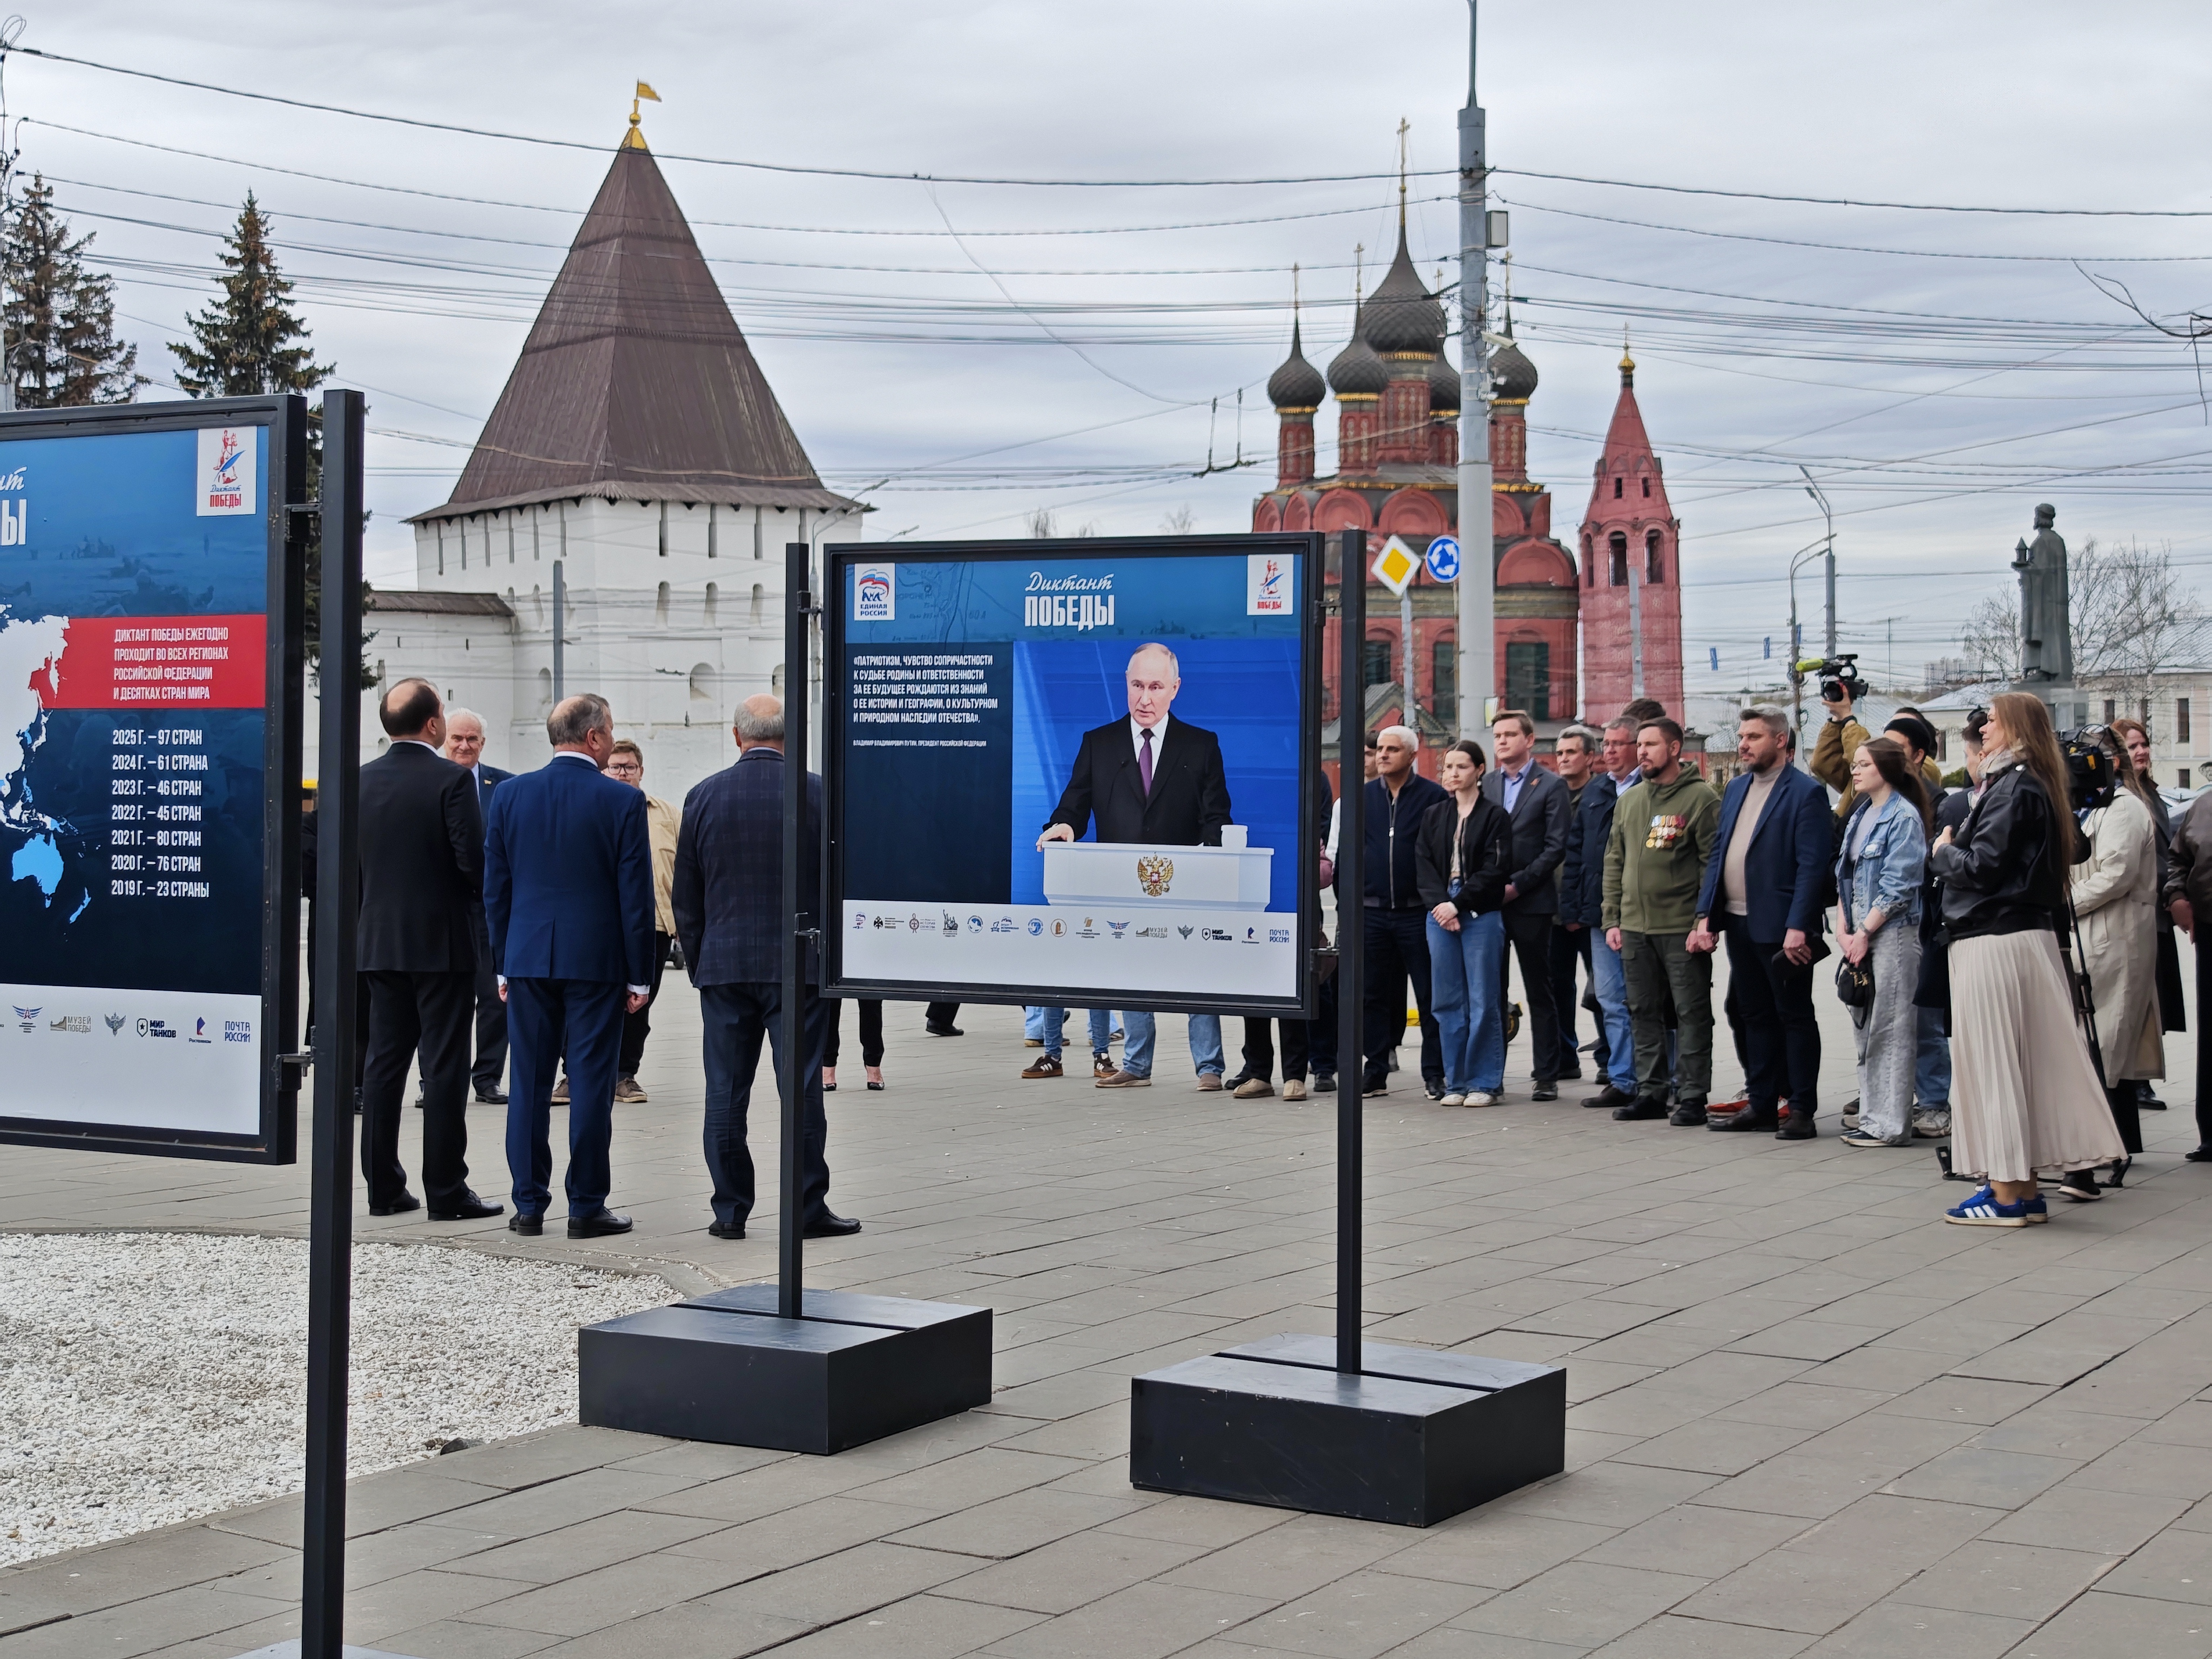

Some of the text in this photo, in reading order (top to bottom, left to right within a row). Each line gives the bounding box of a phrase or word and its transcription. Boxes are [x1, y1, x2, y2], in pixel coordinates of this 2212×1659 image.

[210, 494, 241, 509] ПОБЕДЫ
[1025, 571, 1114, 591] Диктант
[1024, 595, 1115, 632] ПОБЕДЫ
[114, 627, 228, 643] ДИКТАНТ ПОБЕДЫ ЕЖЕГОДНО
[114, 647, 228, 662] ПРОХОДИТ ВО ВСЕХ РЕГИОНАХ
[854, 655, 993, 666] «ПАТРИОТИЗМ, ЧУВСТВО СОПРИЧАСТНОСТИ
[114, 665, 213, 680] РОССИЙСКОЙ ФЕДЕРАЦИИ
[854, 670, 984, 681] К СУДЬБЕ РОДИНЫ И ОТВЕТСТВЕННОСТИ
[113, 686, 210, 701] И ДЕСЯТКАХ СТРАН МИРА
[854, 683, 988, 695] ЗА ЕЕ БУДУЩЕЕ РОЖДАЮТСЯ ИЗ ЗНАНИЙ
[853, 698, 998, 710] О ЕЕ ИСТОРИИ И ГЕОГРАФИИ, О КУЛЬТУРНОМ
[853, 713, 858, 723] И
[859, 713, 899, 724] ПРИРОДНОМ
[901, 713, 937, 724] НАСЛЕДИИ
[113, 730, 136, 745] 2025
[138, 730, 146, 745] Г.
[158, 730, 171, 745] 97
[172, 730, 203, 745] СТРАН
[112, 754, 136, 770] 2024
[138, 755, 146, 770] Г.
[158, 755, 170, 770] 61
[172, 755, 208, 771] СТРАНА
[112, 780, 136, 795] 2023
[138, 780, 146, 795] Г.
[157, 780, 170, 795] 46
[172, 780, 201, 795] СТРАН
[112, 805, 136, 820] 2022
[138, 805, 146, 820] Г.
[157, 806, 170, 821] 45
[171, 806, 201, 821] СТРАН
[111, 830, 134, 845] 2021
[137, 831, 146, 845] Г.
[157, 831, 169, 846] 80
[171, 831, 201, 846] СТРАН
[111, 855, 135, 870] 2020
[137, 855, 145, 871] Г.
[157, 856, 169, 871] 76
[171, 856, 201, 872] СТРАН
[111, 880, 135, 895] 2019
[137, 881, 145, 895] Г.
[157, 881, 169, 896] 23
[171, 881, 209, 898] СТРАНЫ
[68, 1016, 91, 1024] МУЗЕЙ
[150, 1020, 165, 1028] МИР
[225, 1021, 250, 1031] ПОЧТА
[68, 1024, 91, 1034] ПОБЕДЫ
[150, 1029, 177, 1037] ТАНКОВ
[225, 1032, 250, 1042] РОССИИ
